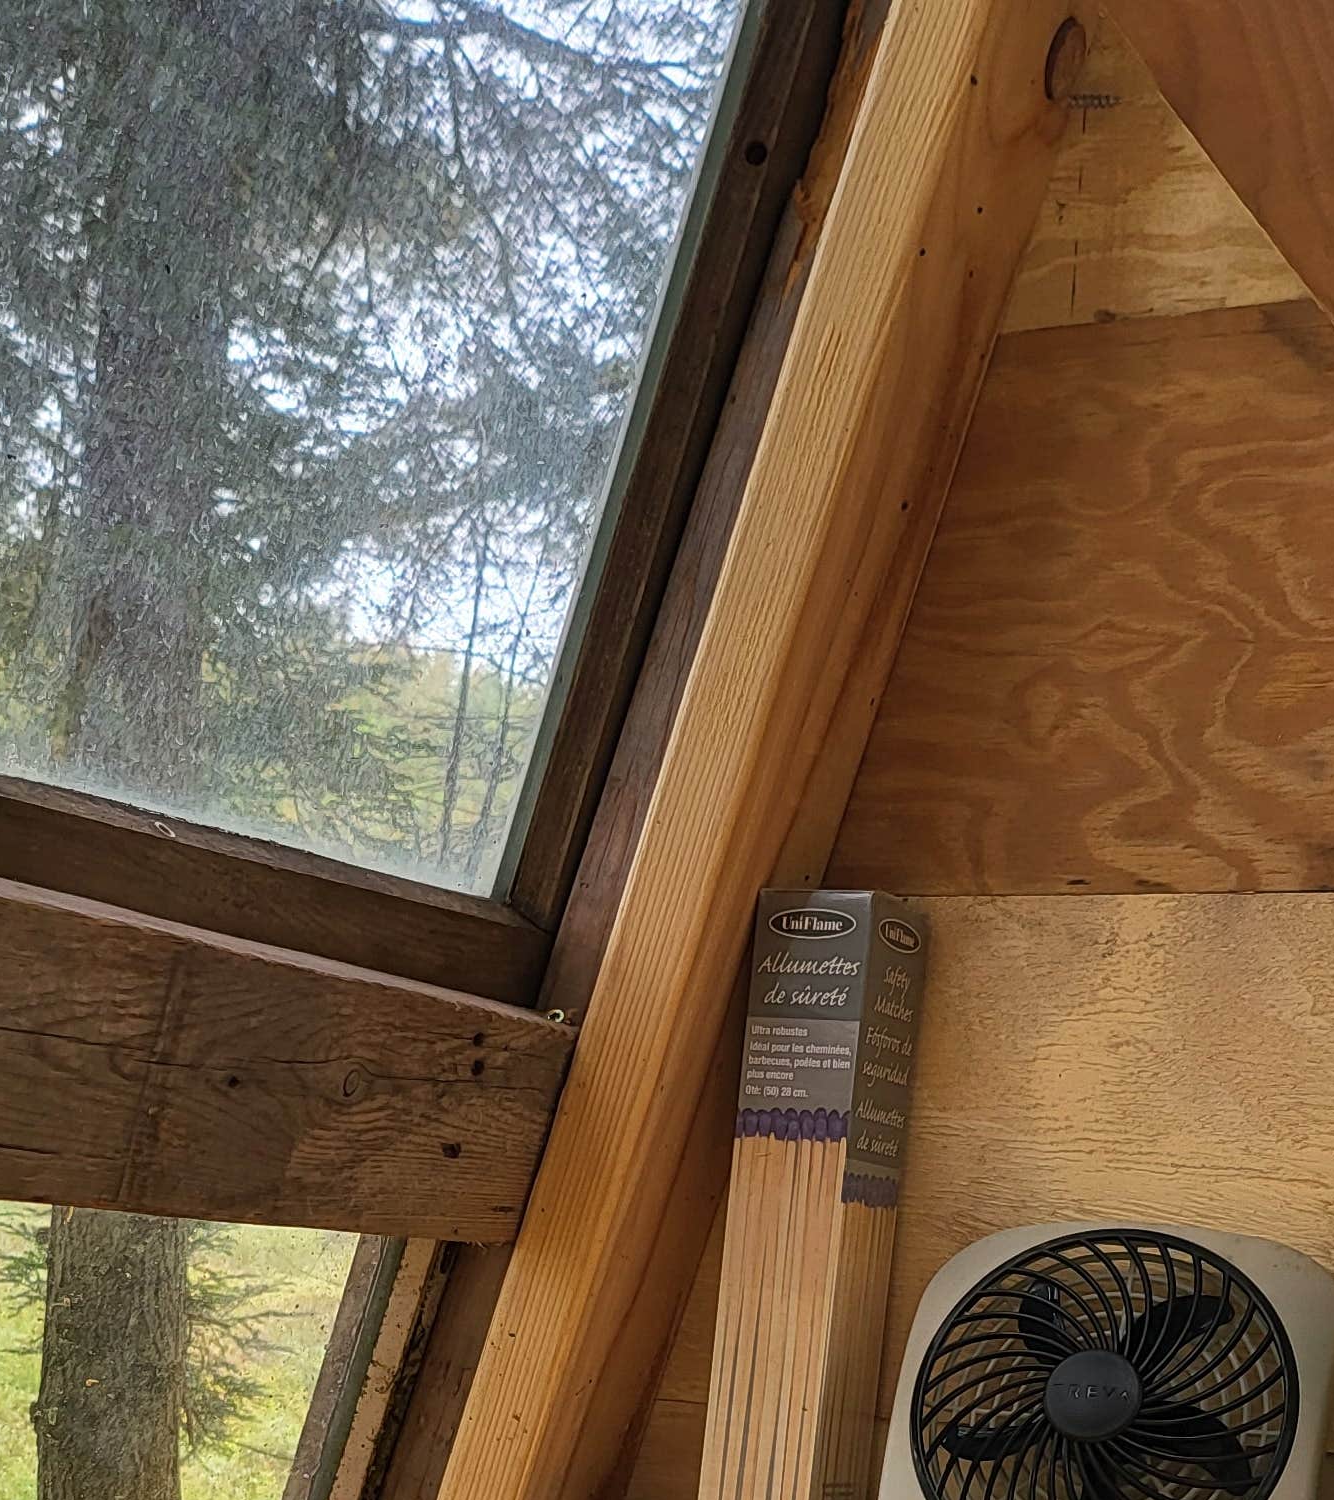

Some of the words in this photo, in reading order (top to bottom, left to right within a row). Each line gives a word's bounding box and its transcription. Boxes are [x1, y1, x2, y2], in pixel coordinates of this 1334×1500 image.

[782, 914, 843, 932] UniFlame
[757, 952, 861, 977] Allumettes
[884, 965, 911, 999] Safety
[764, 983, 784, 1006] de
[792, 984, 848, 1007] sûreté
[874, 995, 914, 1022] Matches
[751, 1025, 771, 1035] Ultra
[772, 1026, 808, 1036] robustes
[771, 1043, 791, 1053] pour
[791, 1043, 804, 1053] les
[806, 1044, 852, 1056] cheminées,
[748, 1055, 793, 1068] barbecues,
[822, 1059, 831, 1068] et
[832, 1059, 851, 1069] bien
[747, 1069, 764, 1080] plus
[766, 1071, 794, 1080] encore
[862, 1060, 910, 1087] seguridad
[763, 1086, 779, 1098] (50)
[793, 1089, 809, 1098] cm.
[857, 1129, 869, 1151] de
